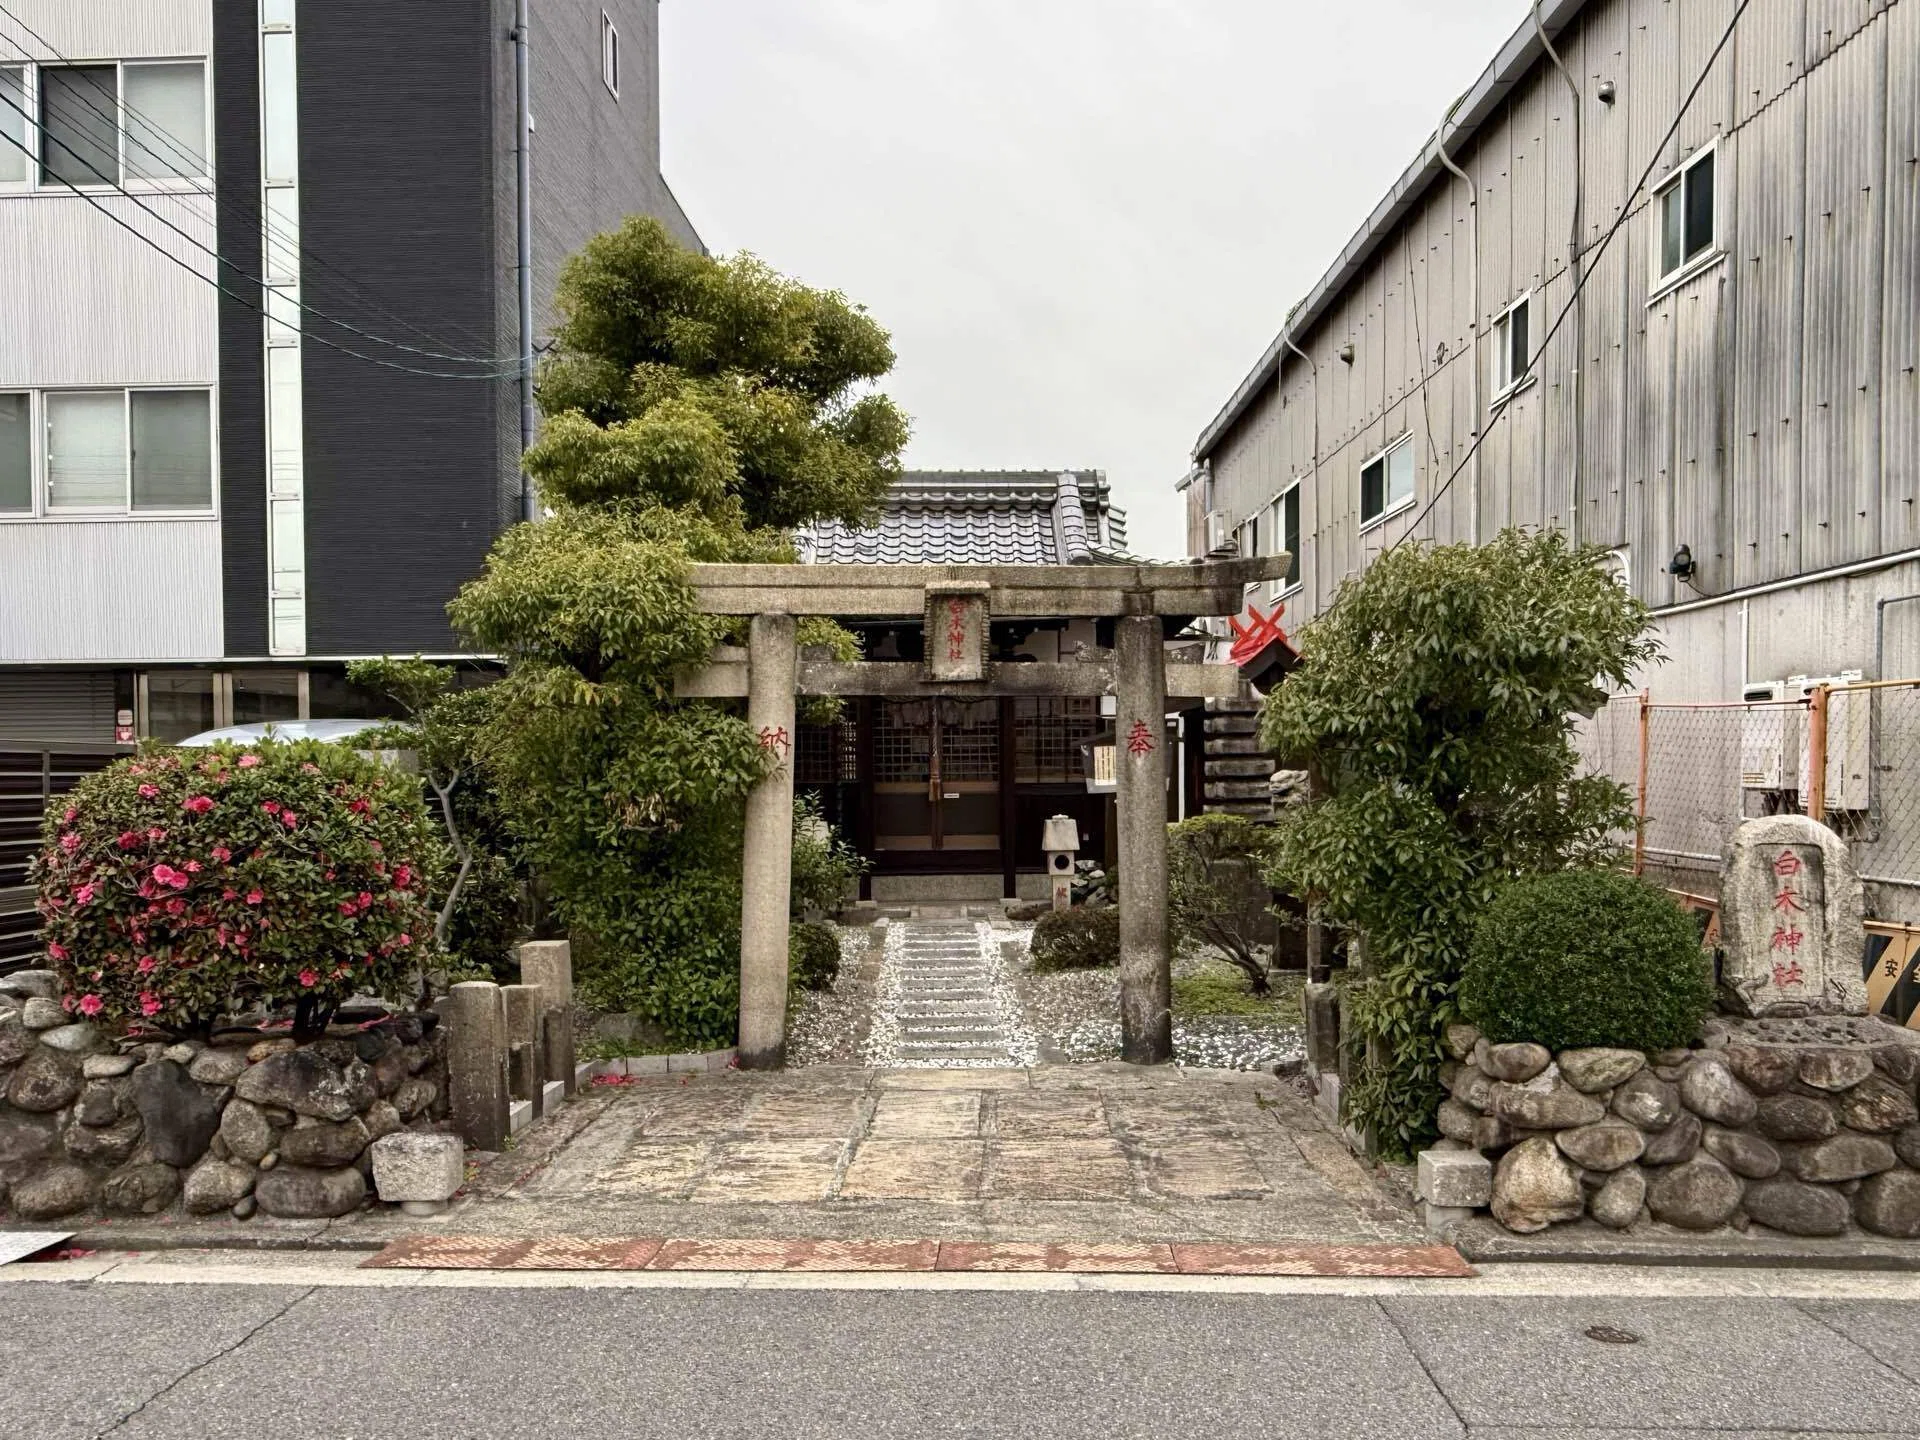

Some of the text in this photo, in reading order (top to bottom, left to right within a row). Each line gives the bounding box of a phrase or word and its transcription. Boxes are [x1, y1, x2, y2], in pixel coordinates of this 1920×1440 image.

[756, 725, 791, 757] 納
[1127, 719, 1155, 757] 奉
[1771, 849, 1805, 988] 白木神社
